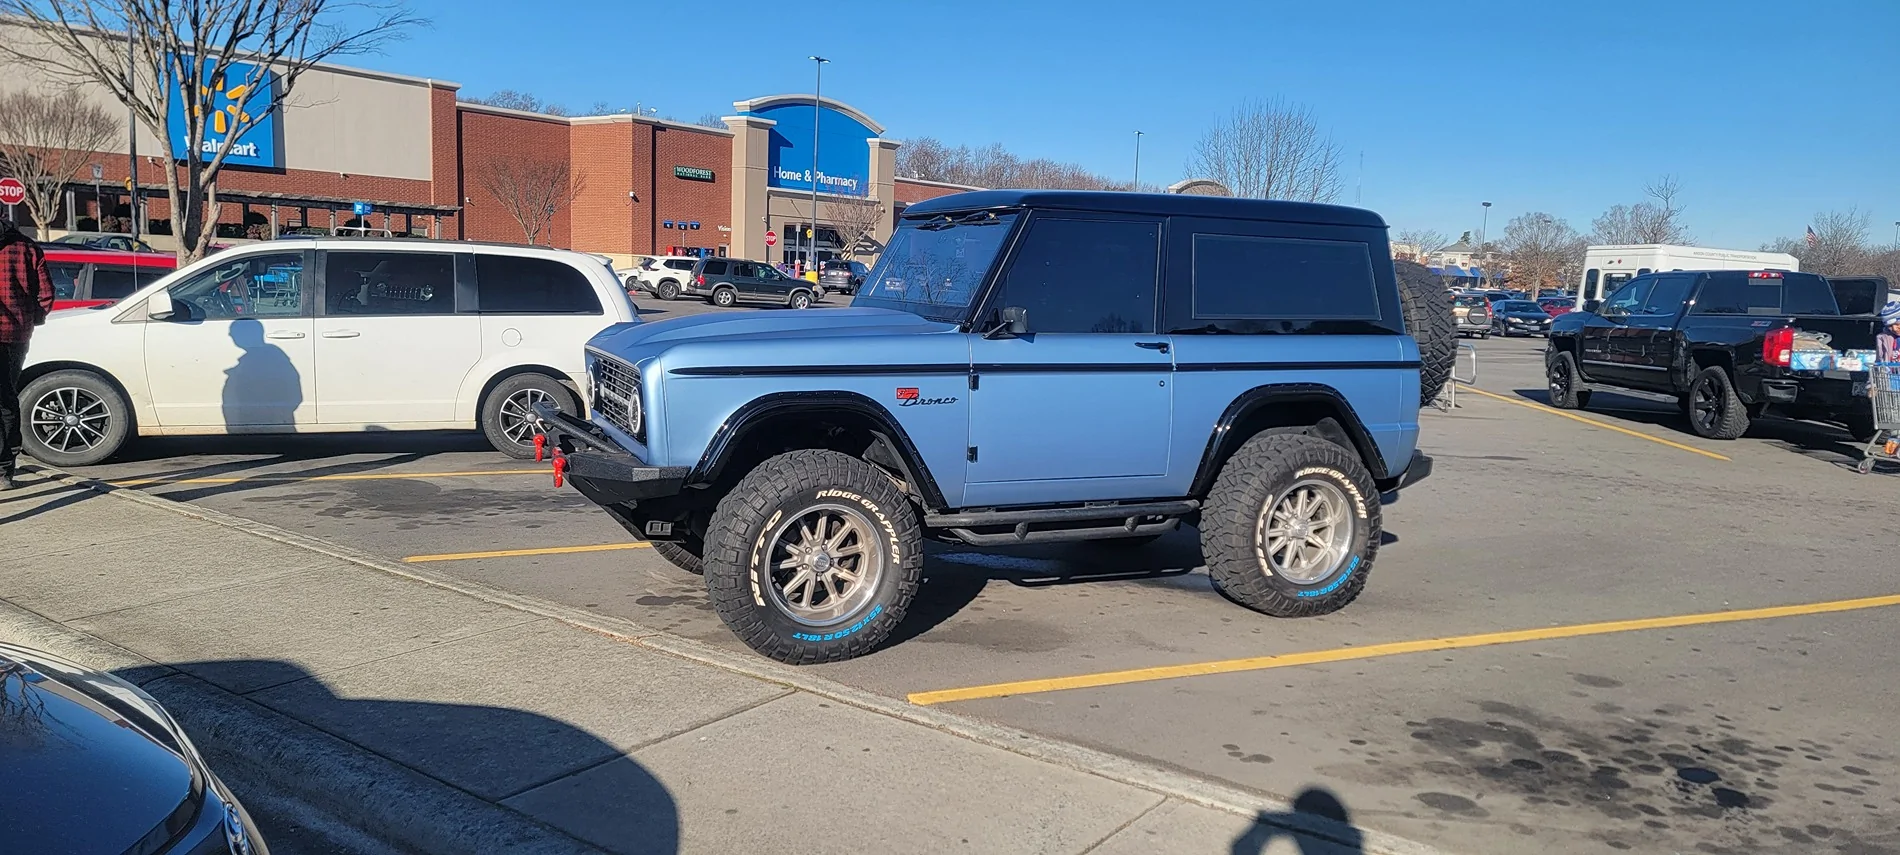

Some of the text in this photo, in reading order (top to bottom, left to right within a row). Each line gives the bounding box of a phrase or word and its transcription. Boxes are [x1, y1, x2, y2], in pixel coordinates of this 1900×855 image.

[184, 136, 257, 157] alart
[676, 166, 712, 176] WOODFOREST
[773, 165, 858, 190] Home & Pharmacy
[0, 185, 23, 197] STOP
[899, 392, 959, 406] Bronco
[1328, 469, 1368, 519] GRAPPLER
[861, 499, 900, 565] GRAPPLER
[750, 509, 783, 607] NITTO
